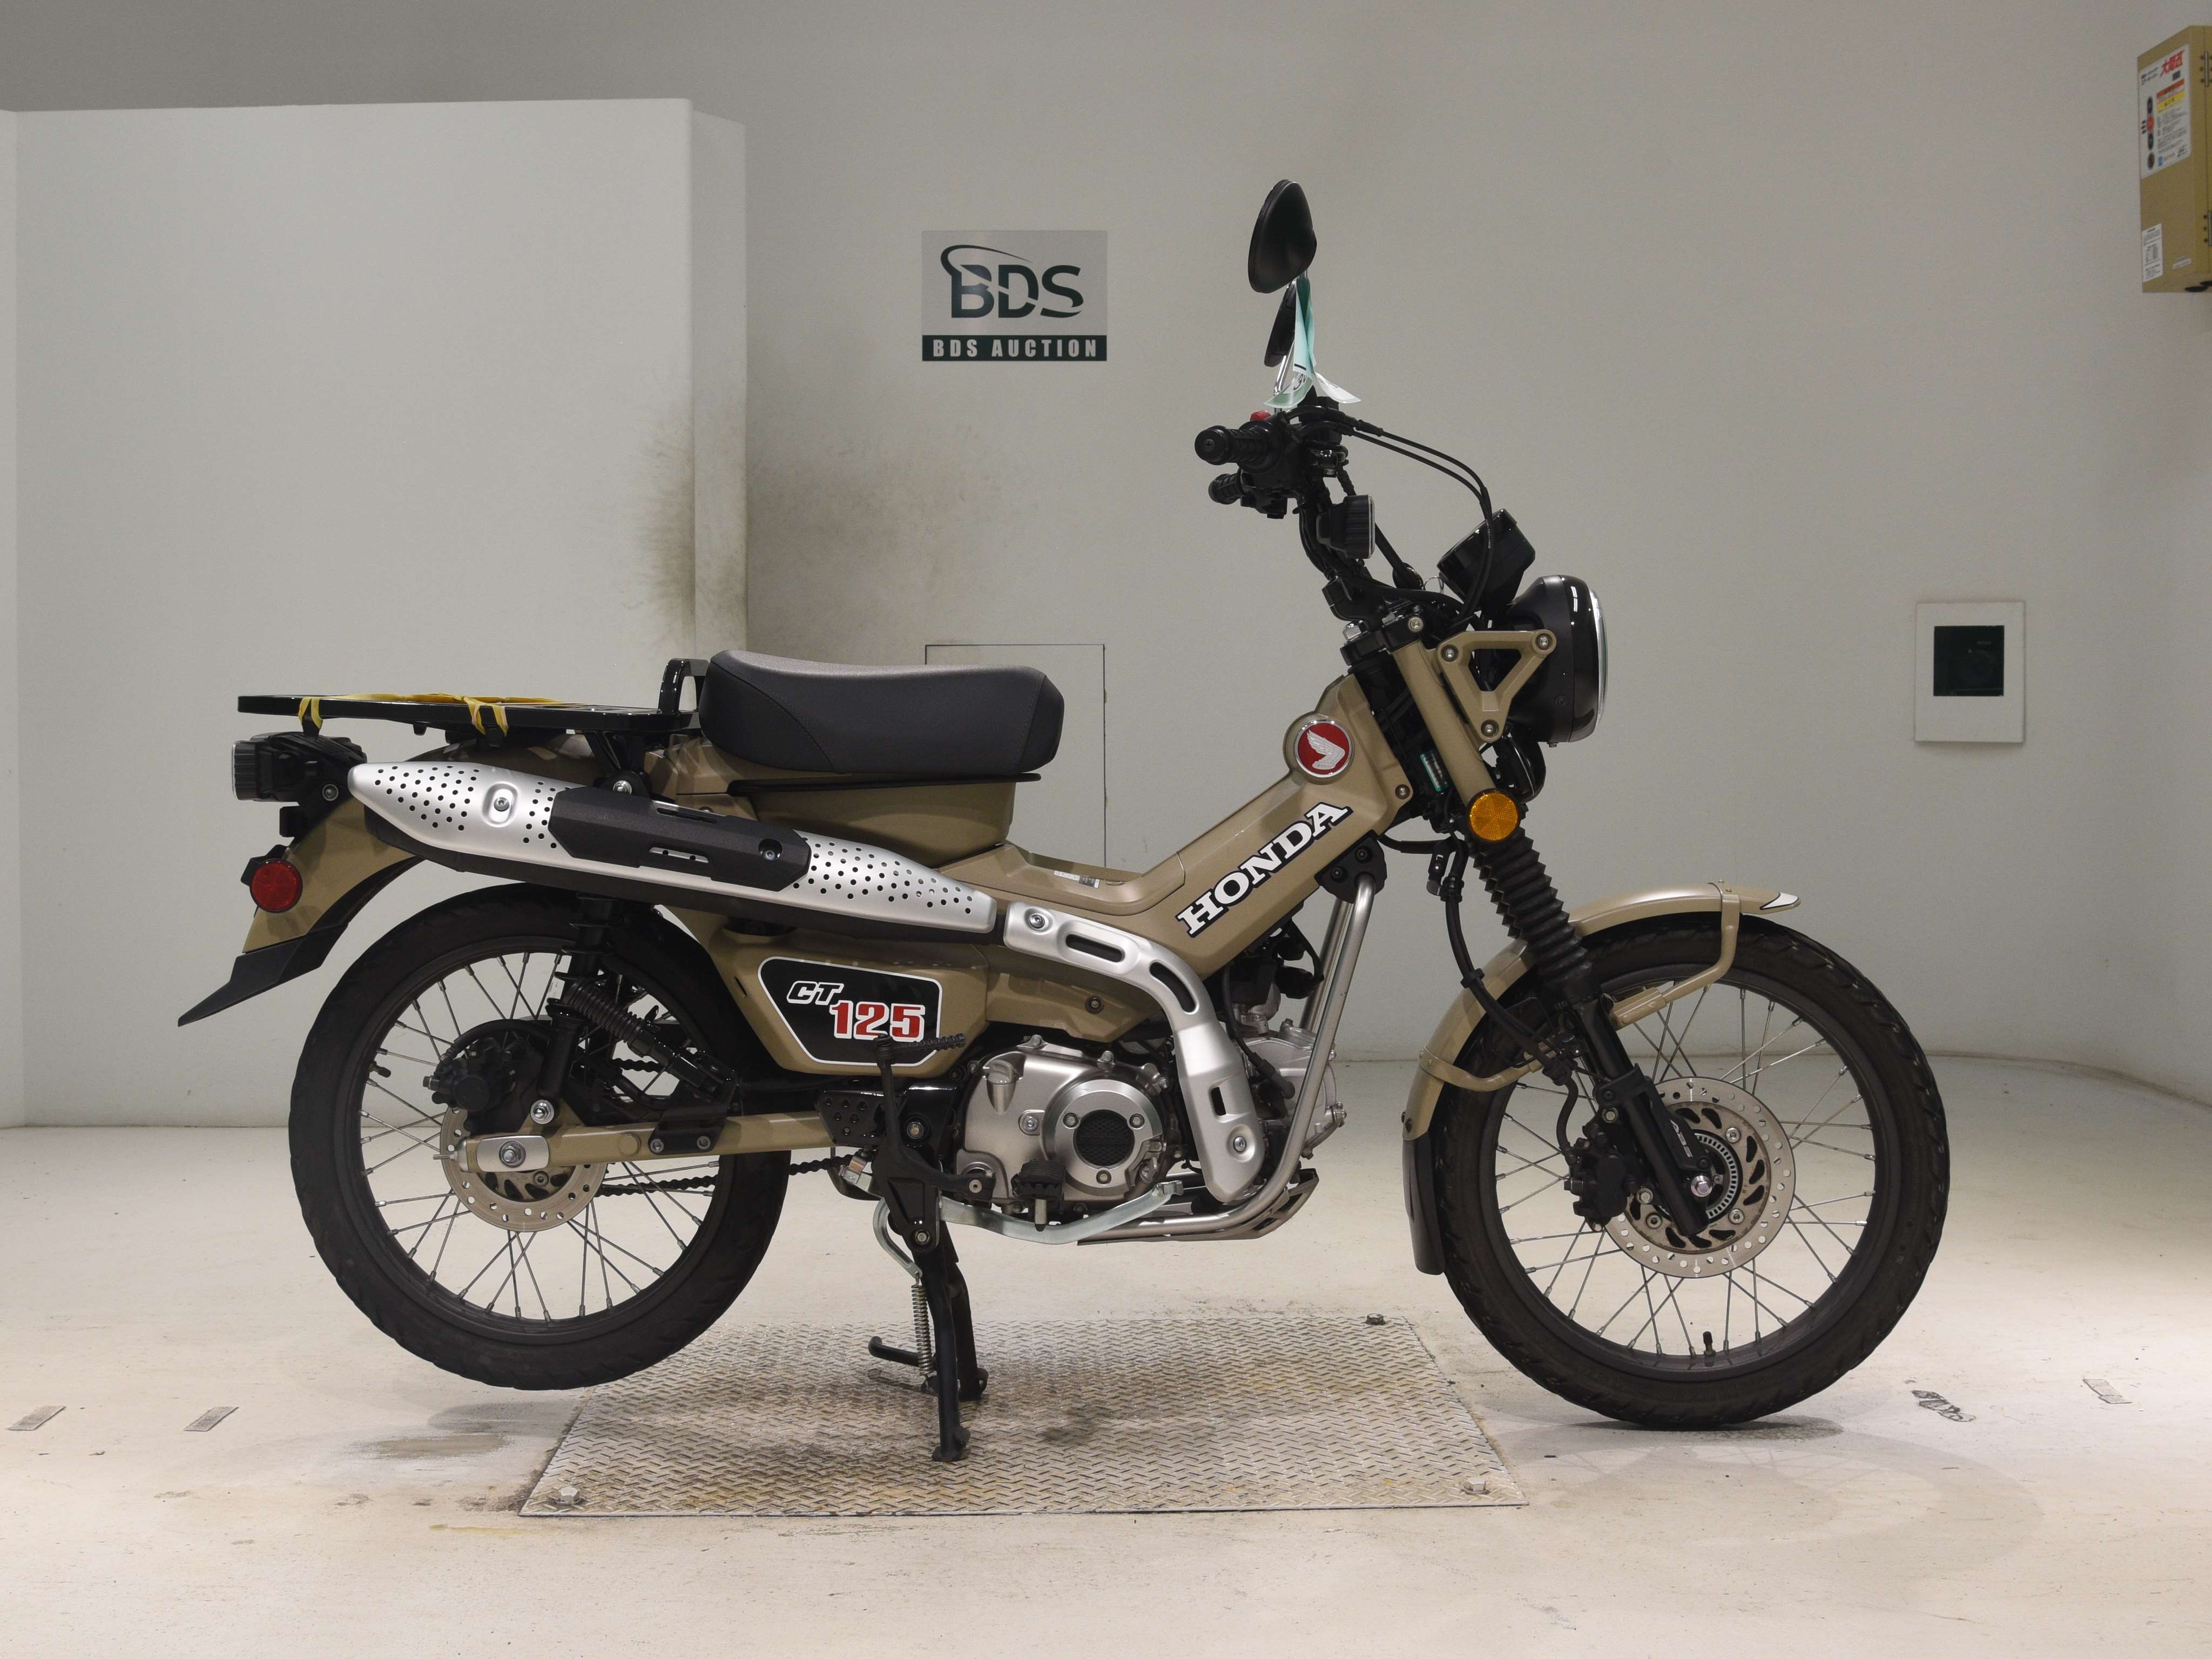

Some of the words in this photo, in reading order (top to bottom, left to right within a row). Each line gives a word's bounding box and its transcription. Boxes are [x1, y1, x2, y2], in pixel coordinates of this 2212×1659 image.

[941, 245, 1084, 319] BDS
[933, 339, 978, 357] BDS
[992, 339, 1096, 357] AUCTION
[1176, 802, 1352, 936] HONDA
[786, 981, 844, 1005] CT
[829, 1000, 926, 1042] 125
[1669, 1118, 1693, 1158] ABS
